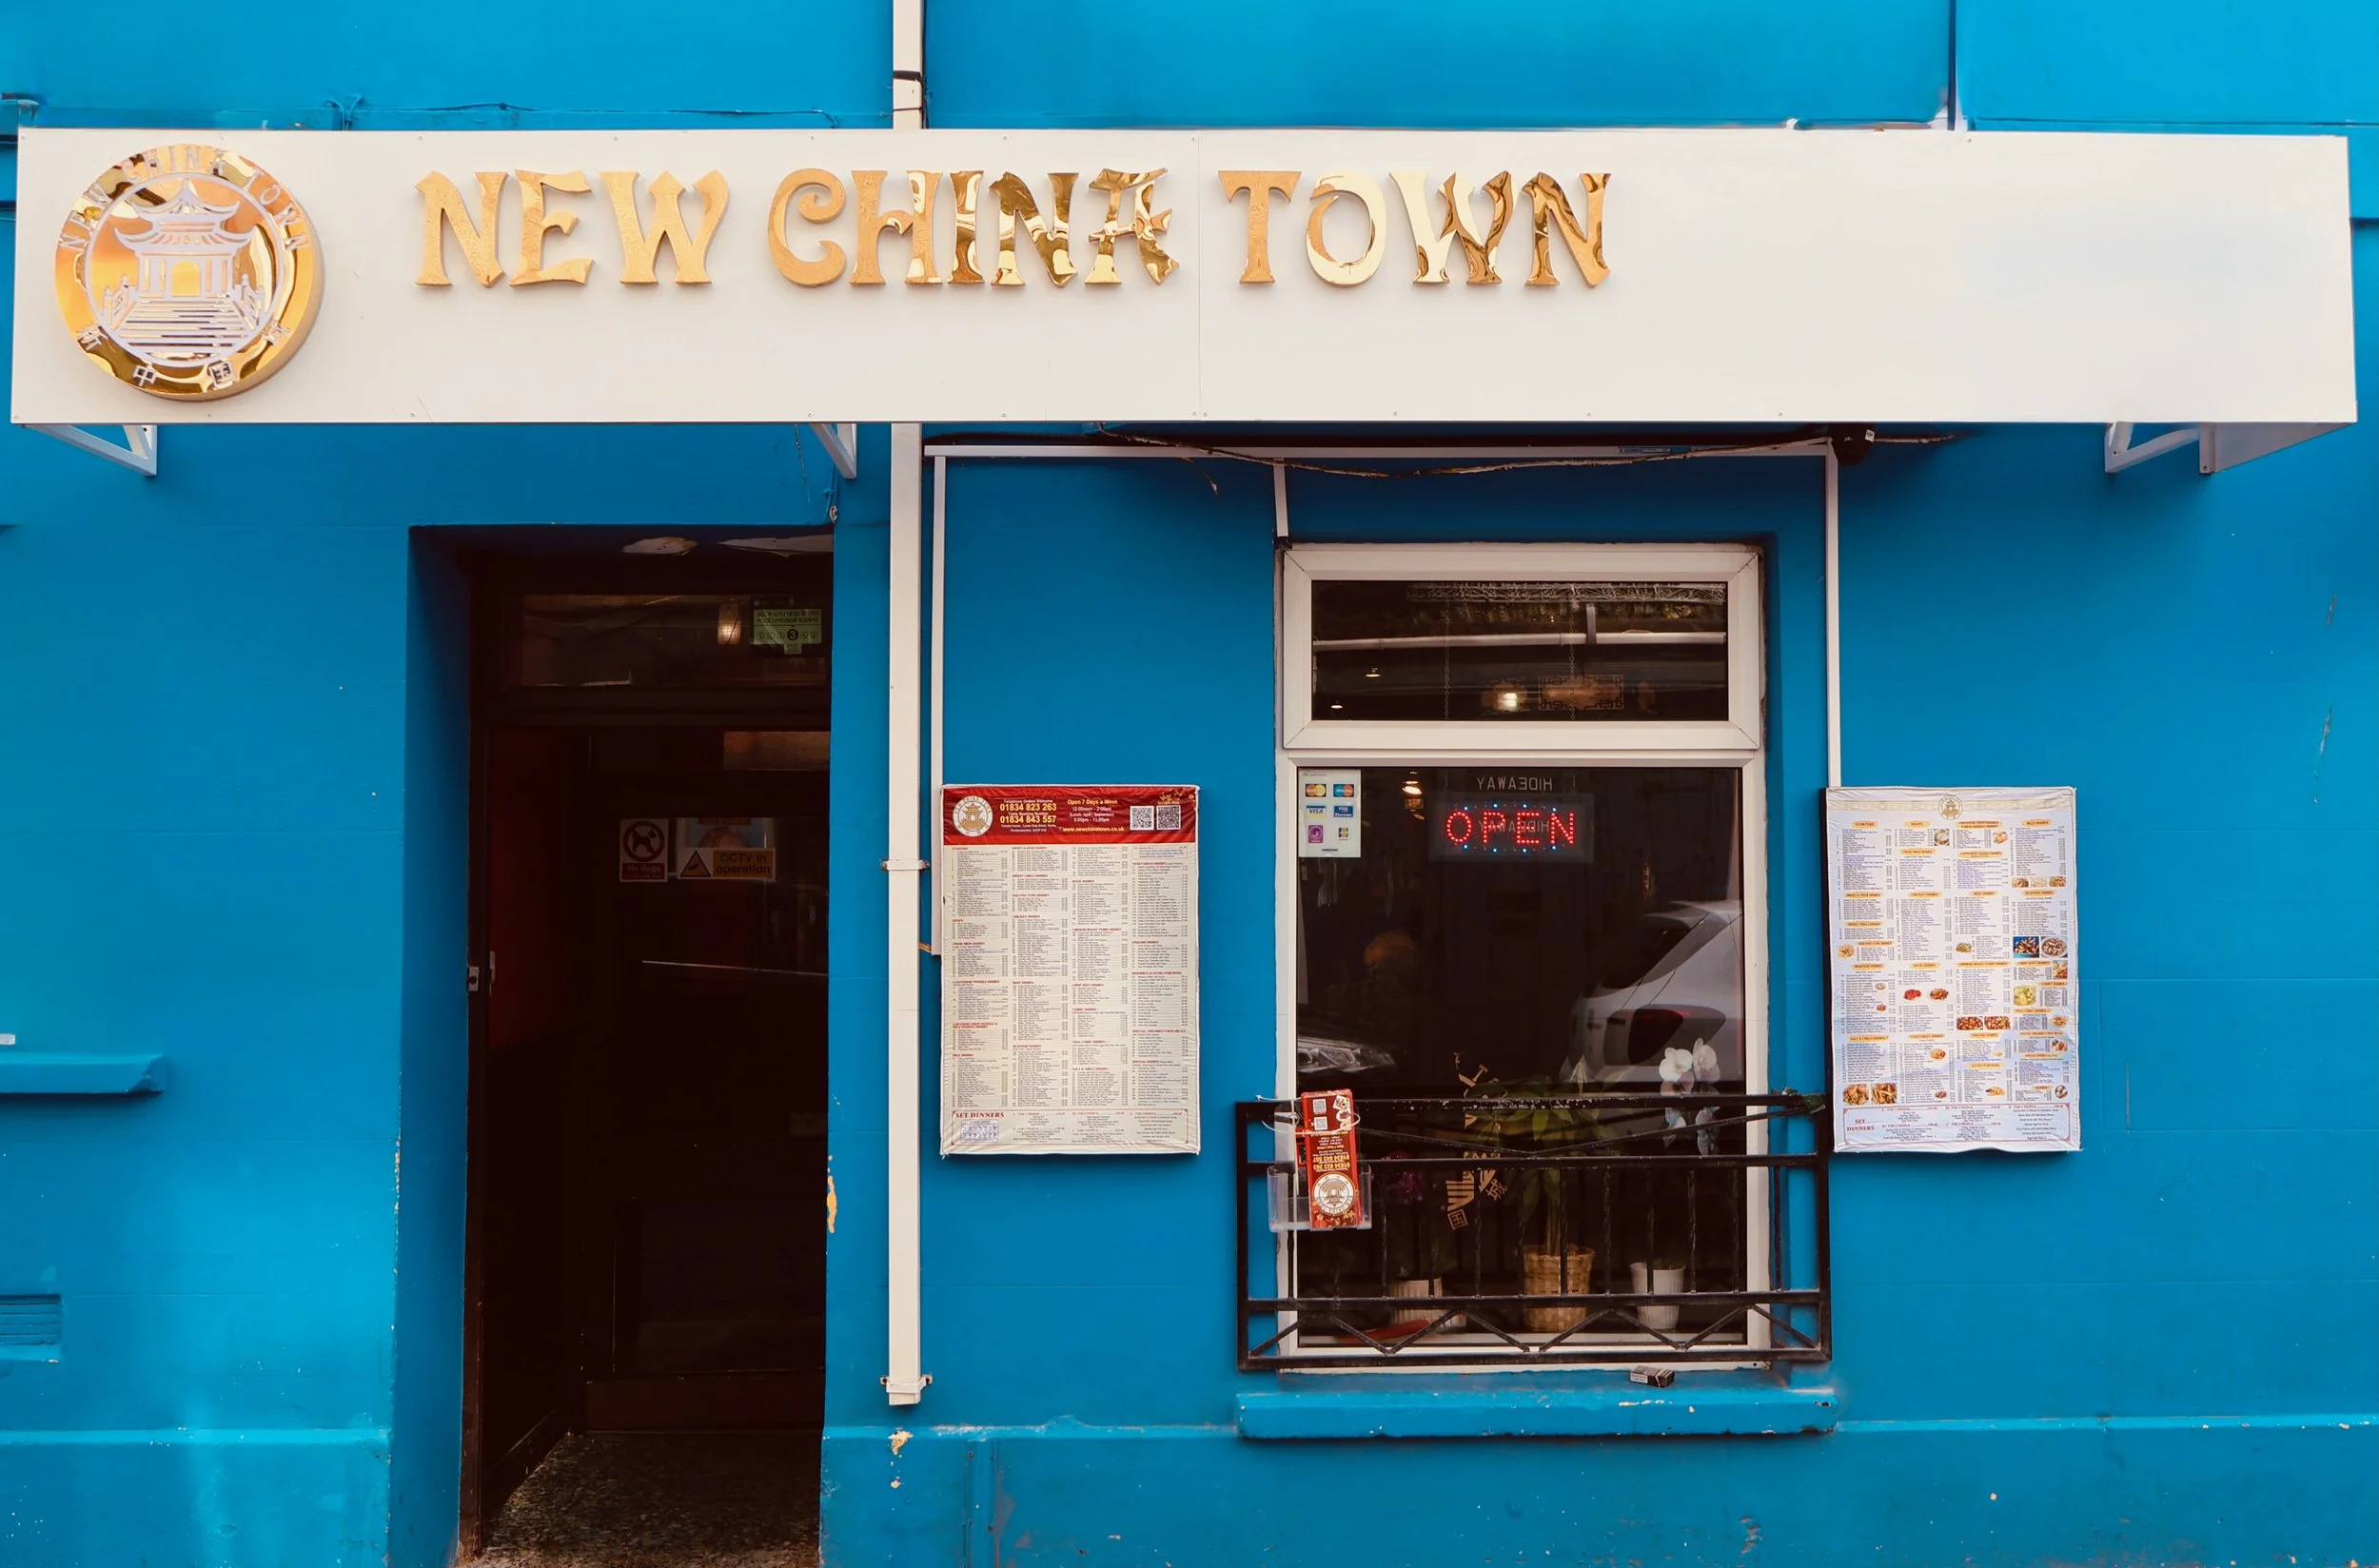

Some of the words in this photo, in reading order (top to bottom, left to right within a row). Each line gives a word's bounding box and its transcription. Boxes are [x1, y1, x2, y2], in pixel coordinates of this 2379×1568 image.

[58, 182, 114, 251] NEW
[120, 144, 227, 184] CHINA
[241, 168, 309, 252] TOWN
[414, 168, 730, 288] NEW
[766, 167, 1181, 288] CHINA
[1218, 169, 1611, 288] TOWN
[1445, 811, 1576, 845] OPEN
[640, 864, 661, 873] dogs
[720, 853, 754, 862] CCTV
[756, 853, 767, 862] in
[716, 865, 771, 875] operation
